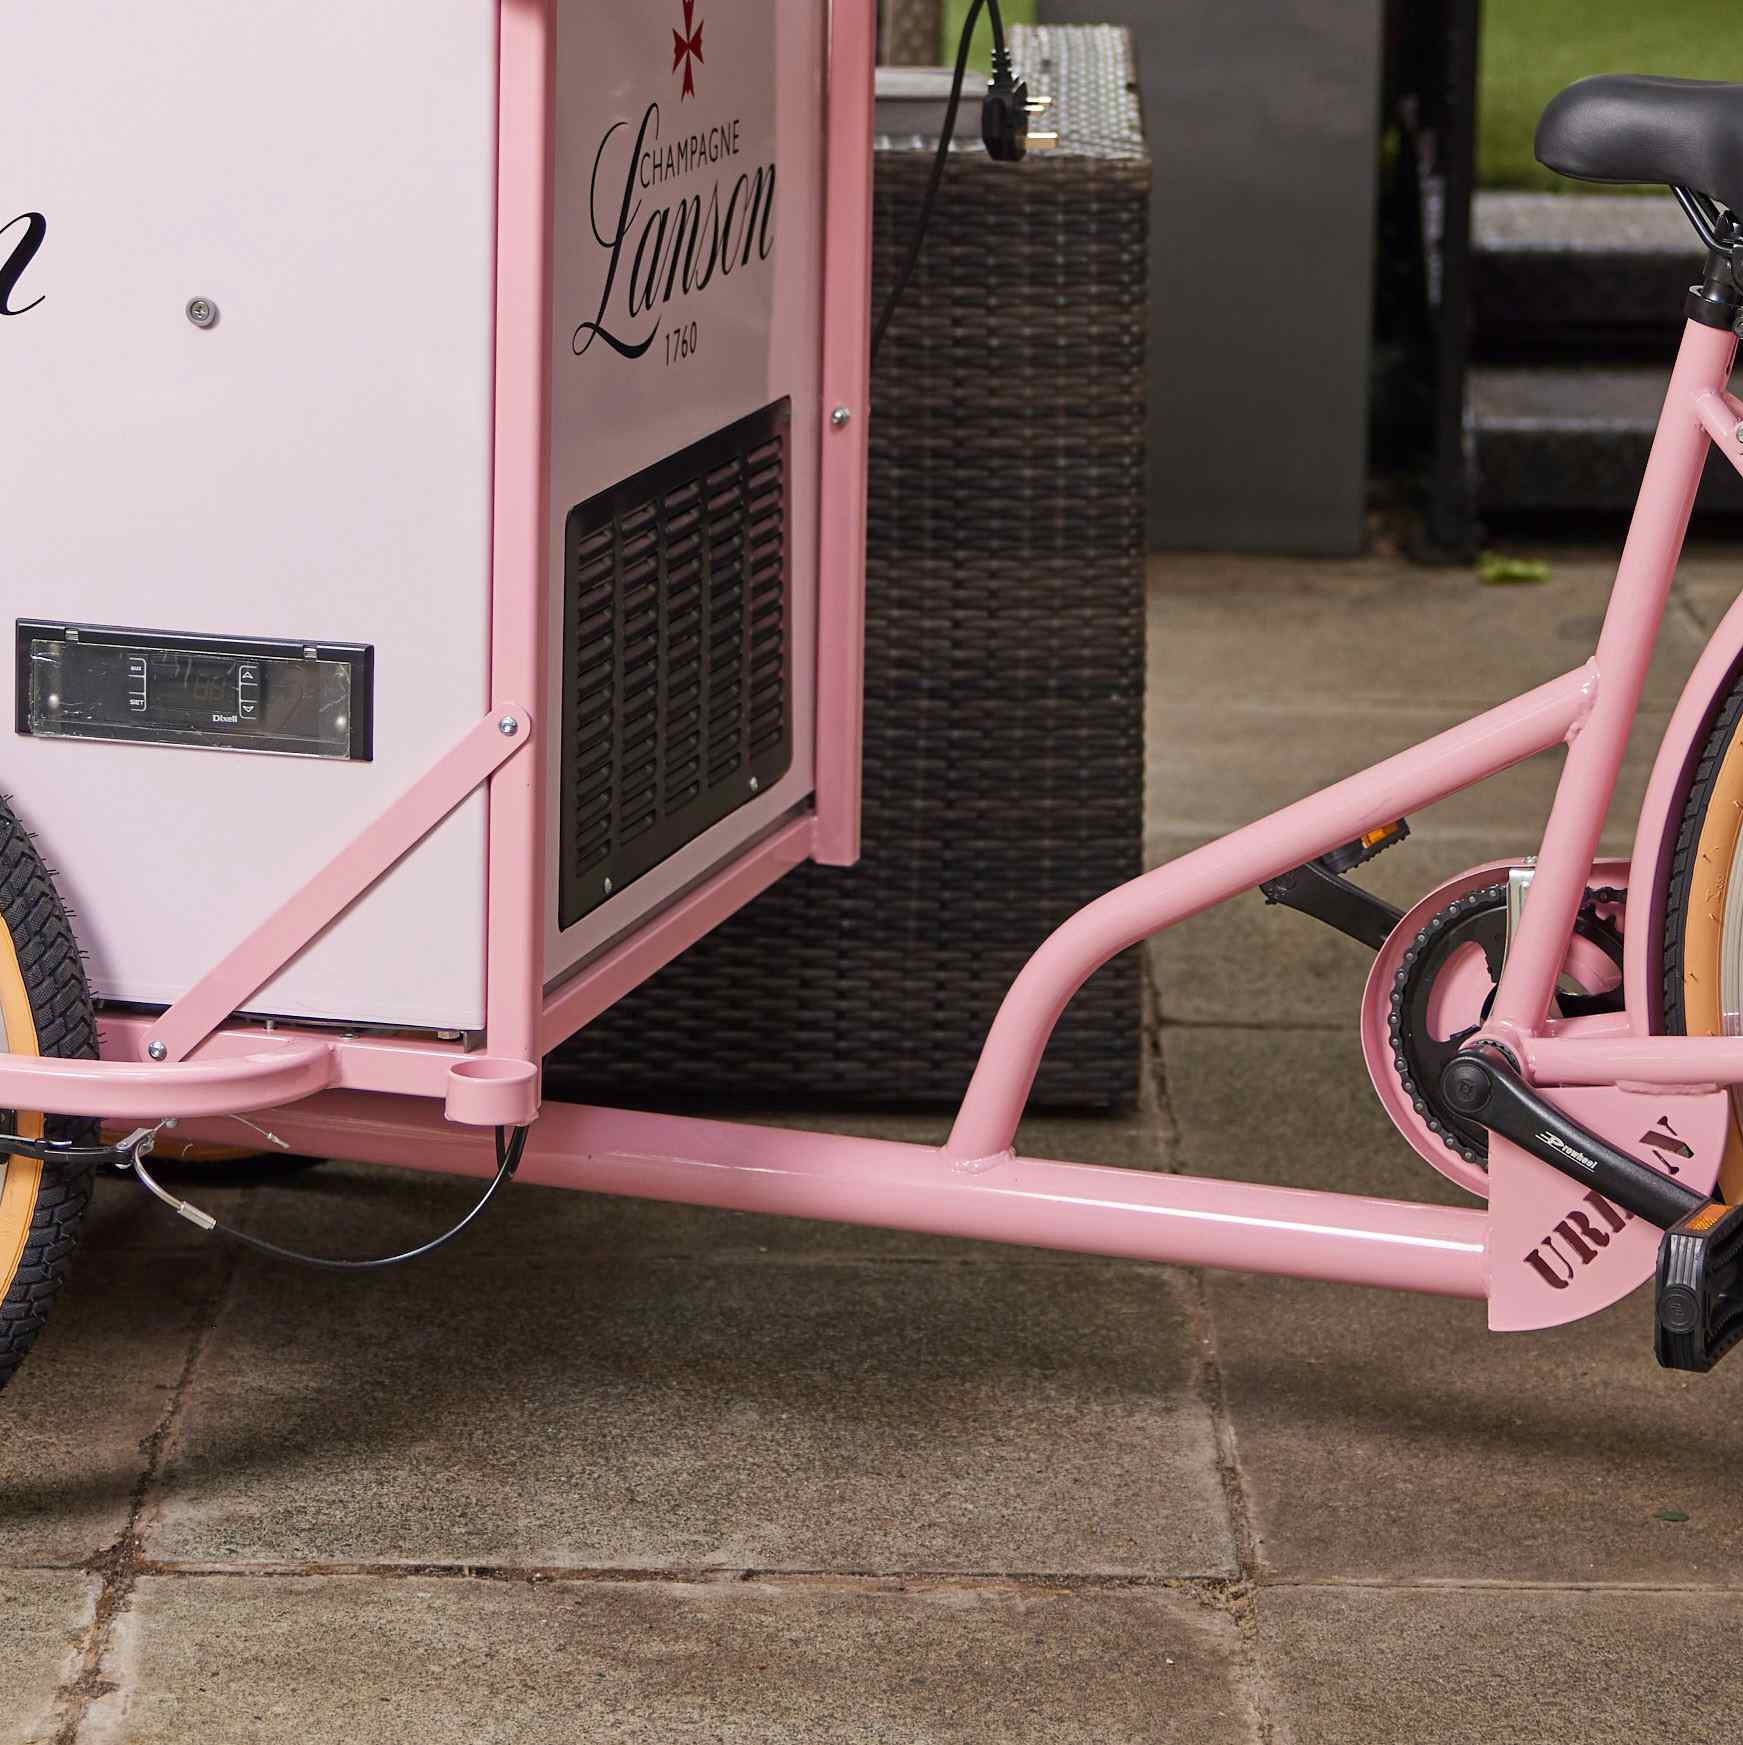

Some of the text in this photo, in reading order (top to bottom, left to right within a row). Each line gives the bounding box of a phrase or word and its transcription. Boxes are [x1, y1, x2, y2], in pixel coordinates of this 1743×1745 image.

[640, 119, 740, 189] CHAMPAGNE
[572, 102, 776, 359] Lanson
[665, 320, 698, 367] 1760
[1535, 1130, 1600, 1172] Prowheel
